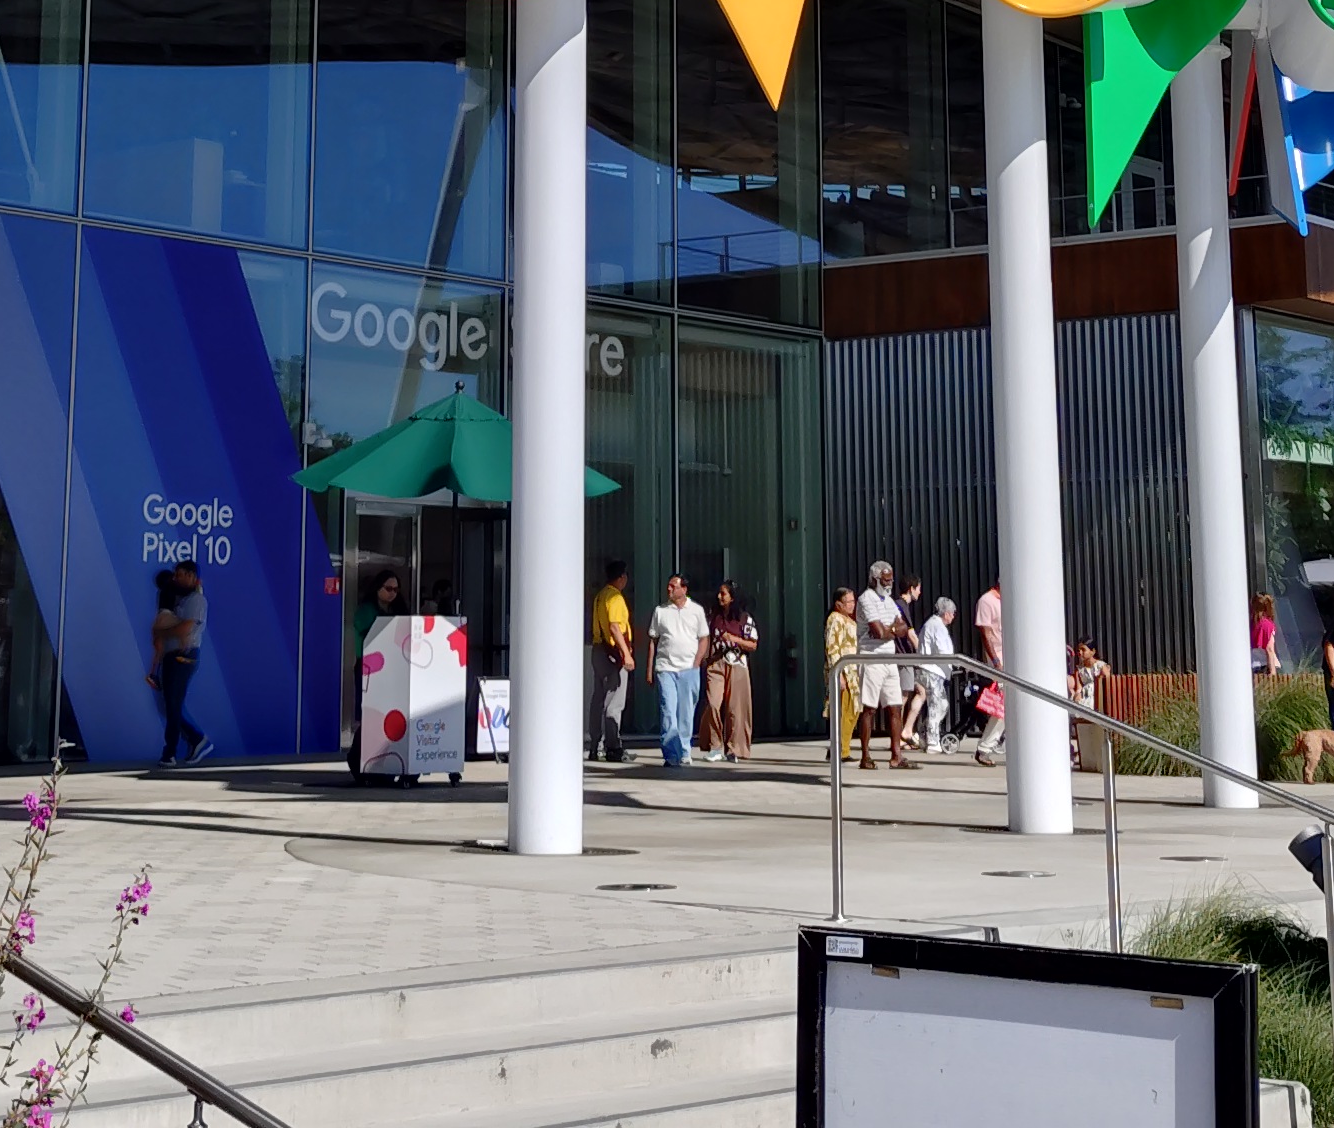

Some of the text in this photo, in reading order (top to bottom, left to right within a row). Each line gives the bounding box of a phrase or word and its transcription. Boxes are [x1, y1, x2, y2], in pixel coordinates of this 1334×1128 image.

[311, 282, 488, 371] Google
[143, 493, 234, 535] Google
[142, 531, 232, 565] Pixel 10
